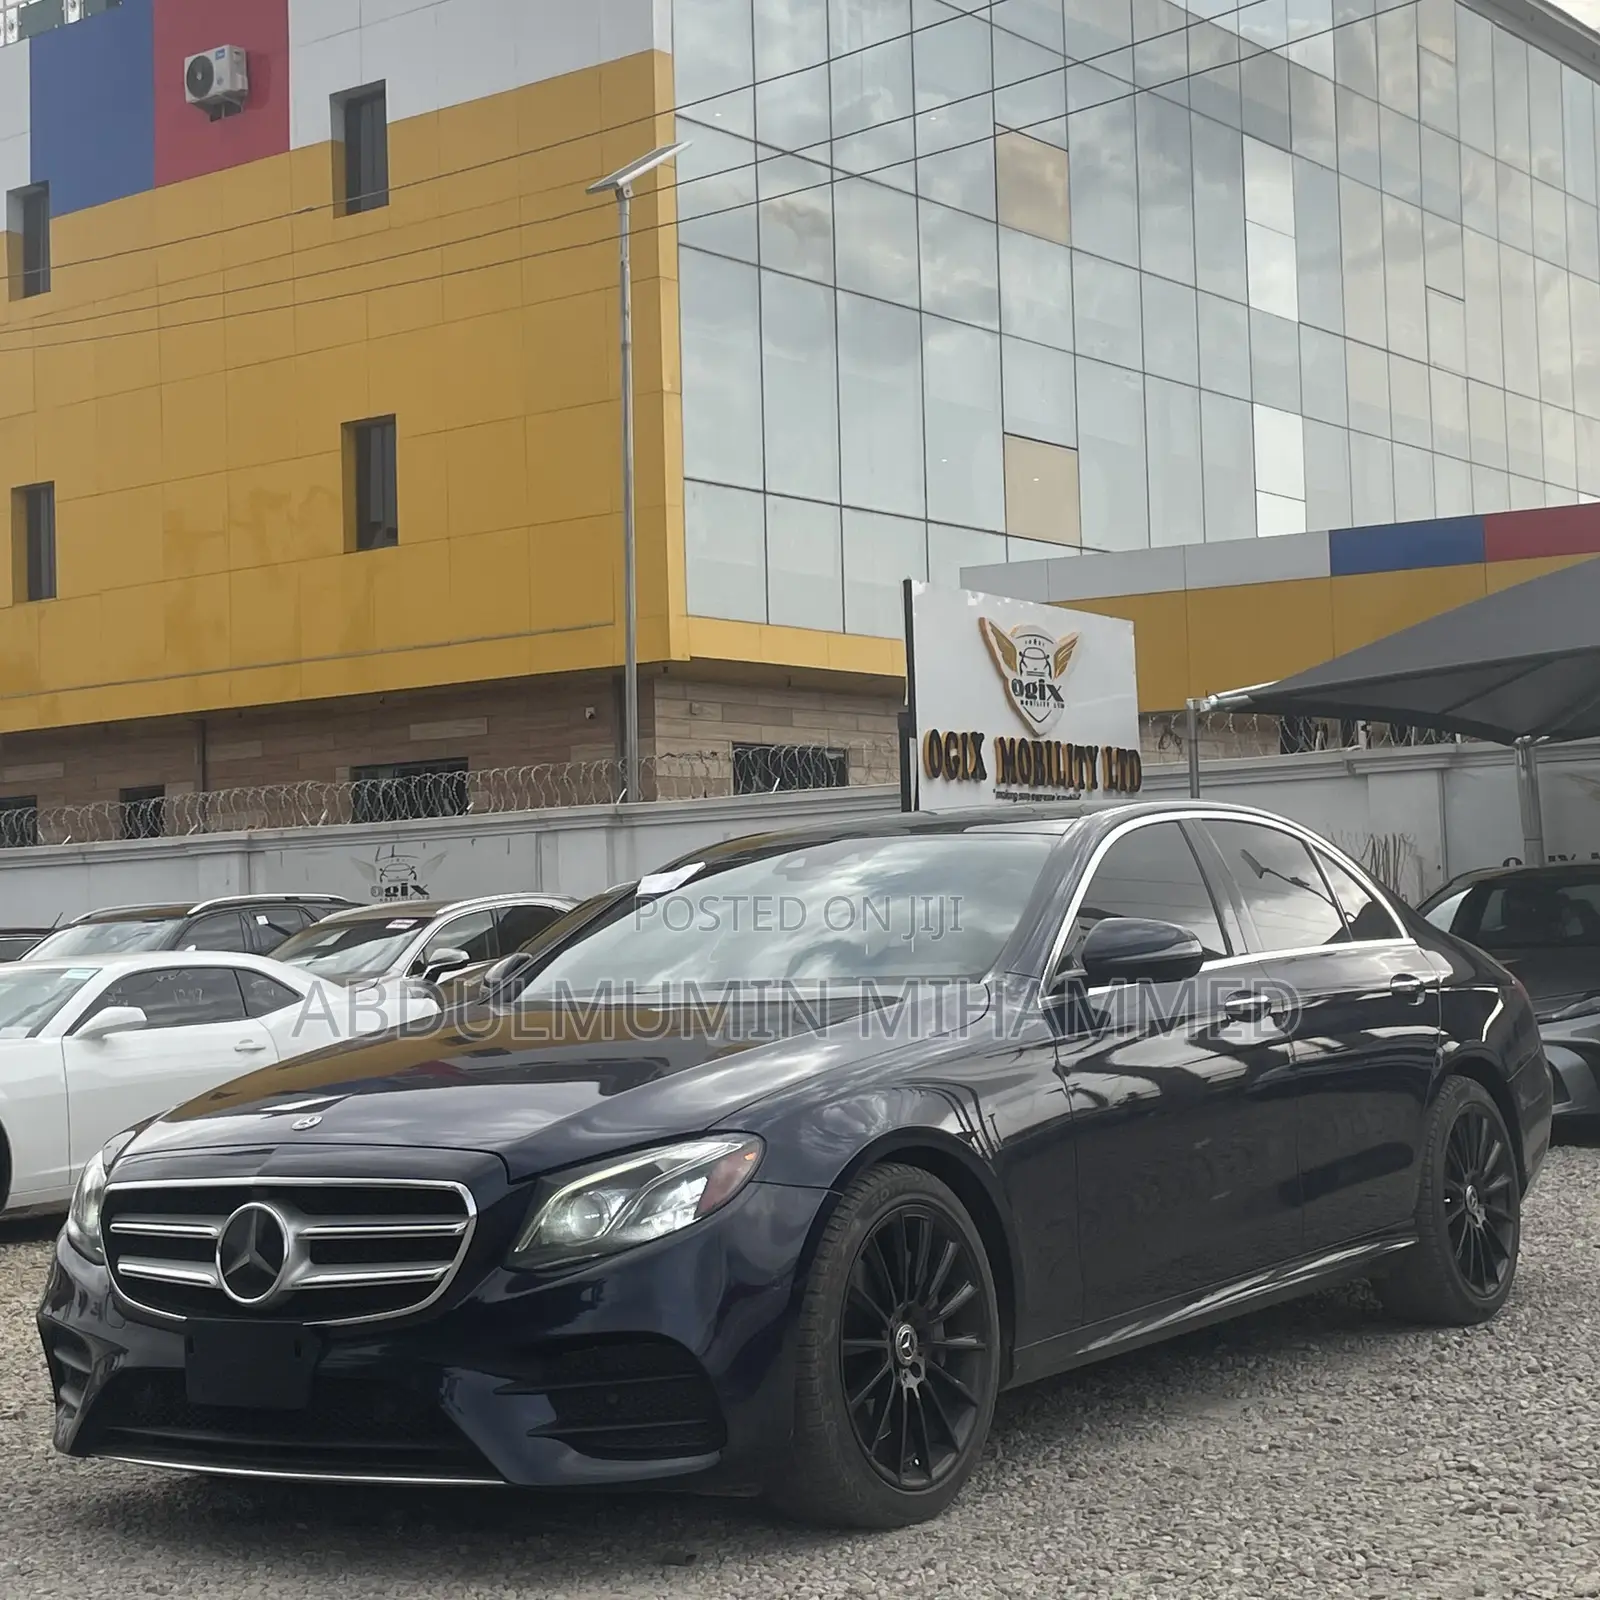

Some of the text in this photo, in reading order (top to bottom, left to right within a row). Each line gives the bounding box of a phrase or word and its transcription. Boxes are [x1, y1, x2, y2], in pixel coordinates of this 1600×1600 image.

[923, 728, 1142, 793] OGIX MOBILITY LTD
